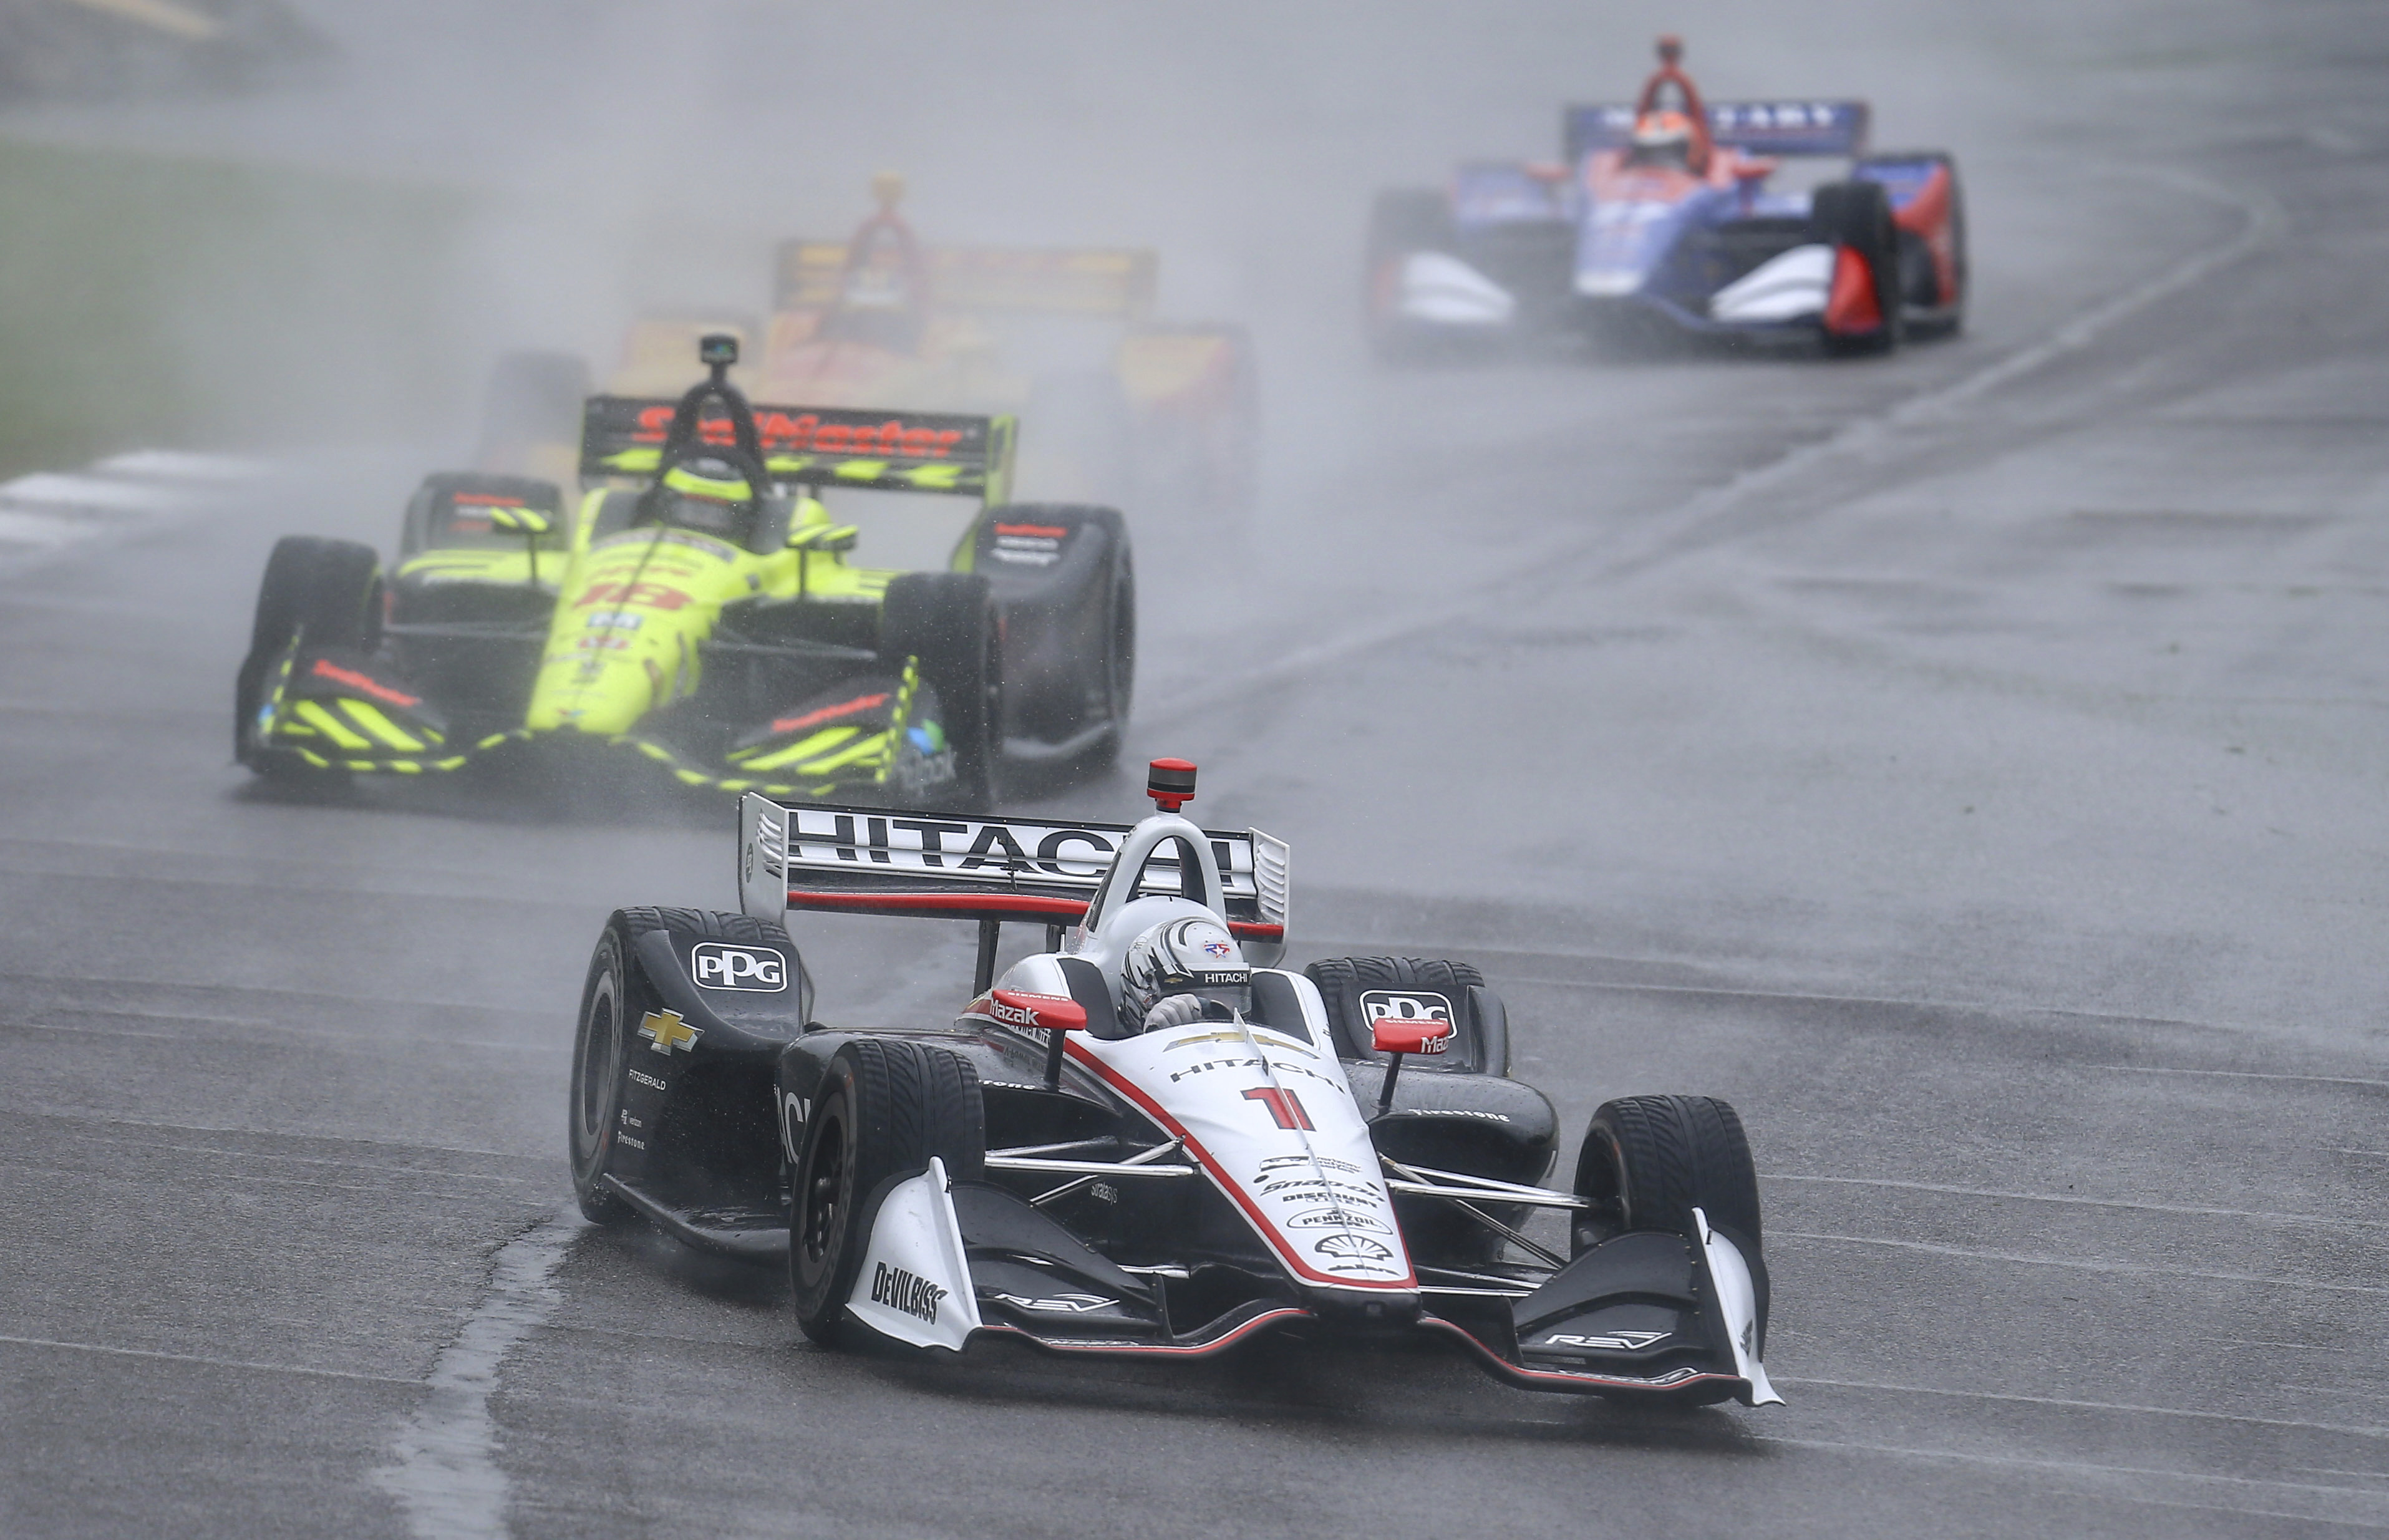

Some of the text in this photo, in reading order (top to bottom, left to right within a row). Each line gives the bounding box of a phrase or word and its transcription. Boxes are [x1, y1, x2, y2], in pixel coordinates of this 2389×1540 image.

[788, 812, 1234, 888] HITACI
[698, 950, 781, 986] PPG
[1204, 973, 1248, 983] HITACHI
[989, 999, 1040, 1026] Mazak
[1420, 1036, 1450, 1053] Maz
[629, 1069, 666, 1091] FITZGERALD
[1170, 1059, 1345, 1095] HITACHI
[1240, 1087, 1317, 1131] 1
[1408, 1108, 1511, 1123] Firestone
[618, 1130, 645, 1150] Firestone
[1302, 1215, 1378, 1227] PENNZOIL
